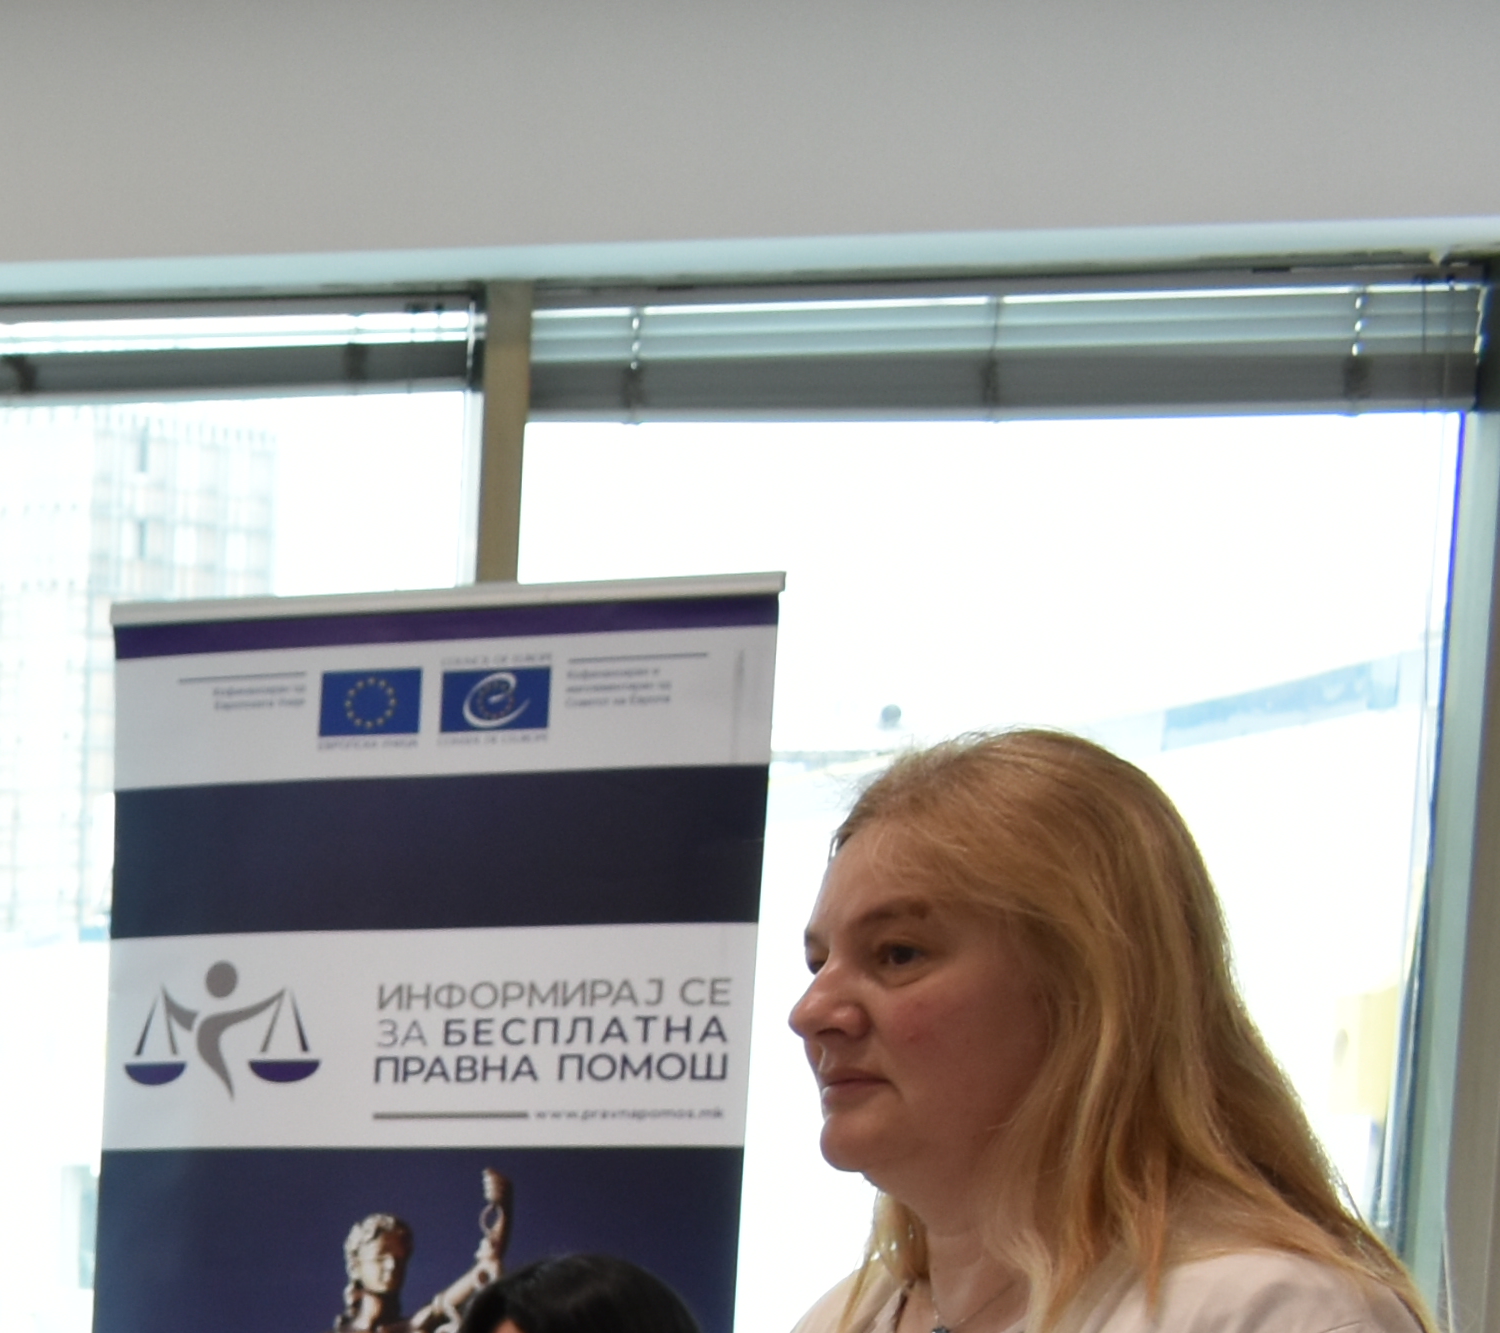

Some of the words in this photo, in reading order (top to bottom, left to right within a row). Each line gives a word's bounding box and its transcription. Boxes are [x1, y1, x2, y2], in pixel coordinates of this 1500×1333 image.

[376, 978, 664, 1010] ИНФОРМИРАЈ
[679, 977, 732, 1007] СЕ
[376, 1018, 428, 1048] ЗА
[442, 1014, 728, 1047] БЕСПЛАТНА
[372, 1053, 538, 1084] ПРАВНА
[557, 1051, 729, 1082] ПОМОШ
